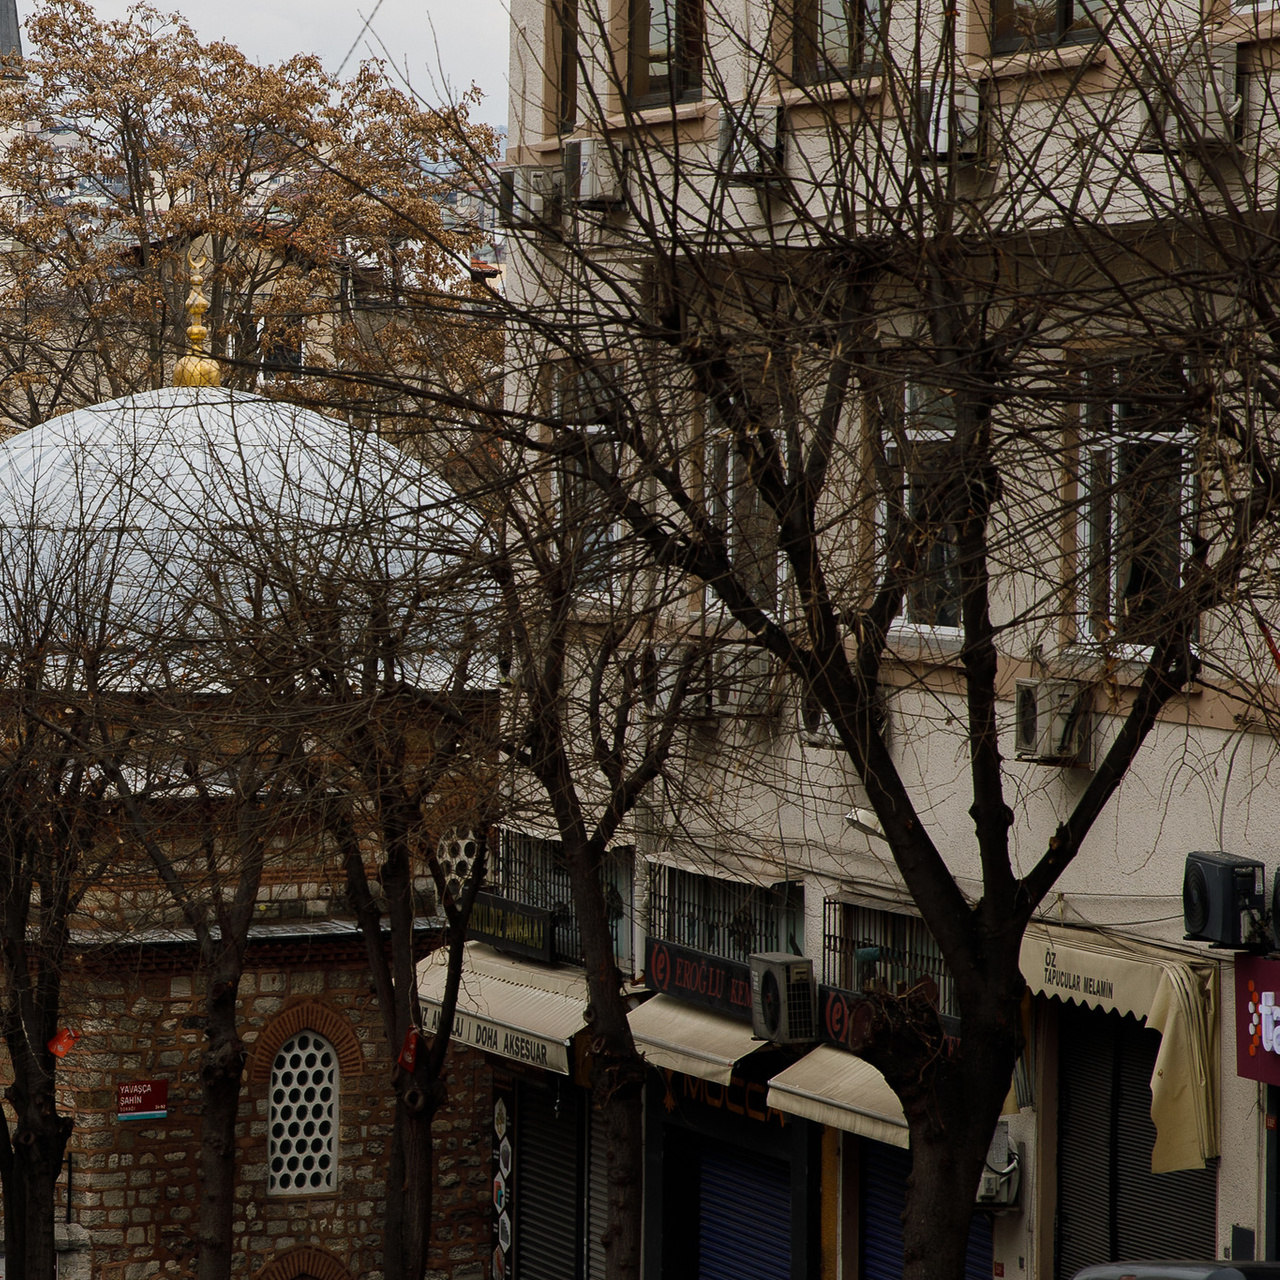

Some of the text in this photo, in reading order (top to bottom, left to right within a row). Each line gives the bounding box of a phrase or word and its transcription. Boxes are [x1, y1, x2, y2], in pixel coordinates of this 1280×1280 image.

[1045, 948, 1057, 969] ÖZ
[675, 958, 725, 998] EROĞLU
[1044, 967, 1114, 1000] TAPUCULAR MELAMİN
[476, 1024, 498, 1050] DOHA
[503, 1032, 548, 1066] AKSESUAR
[120, 1084, 152, 1094] YAVAŞÇA
[120, 1095, 142, 1107] ŞAHİN
